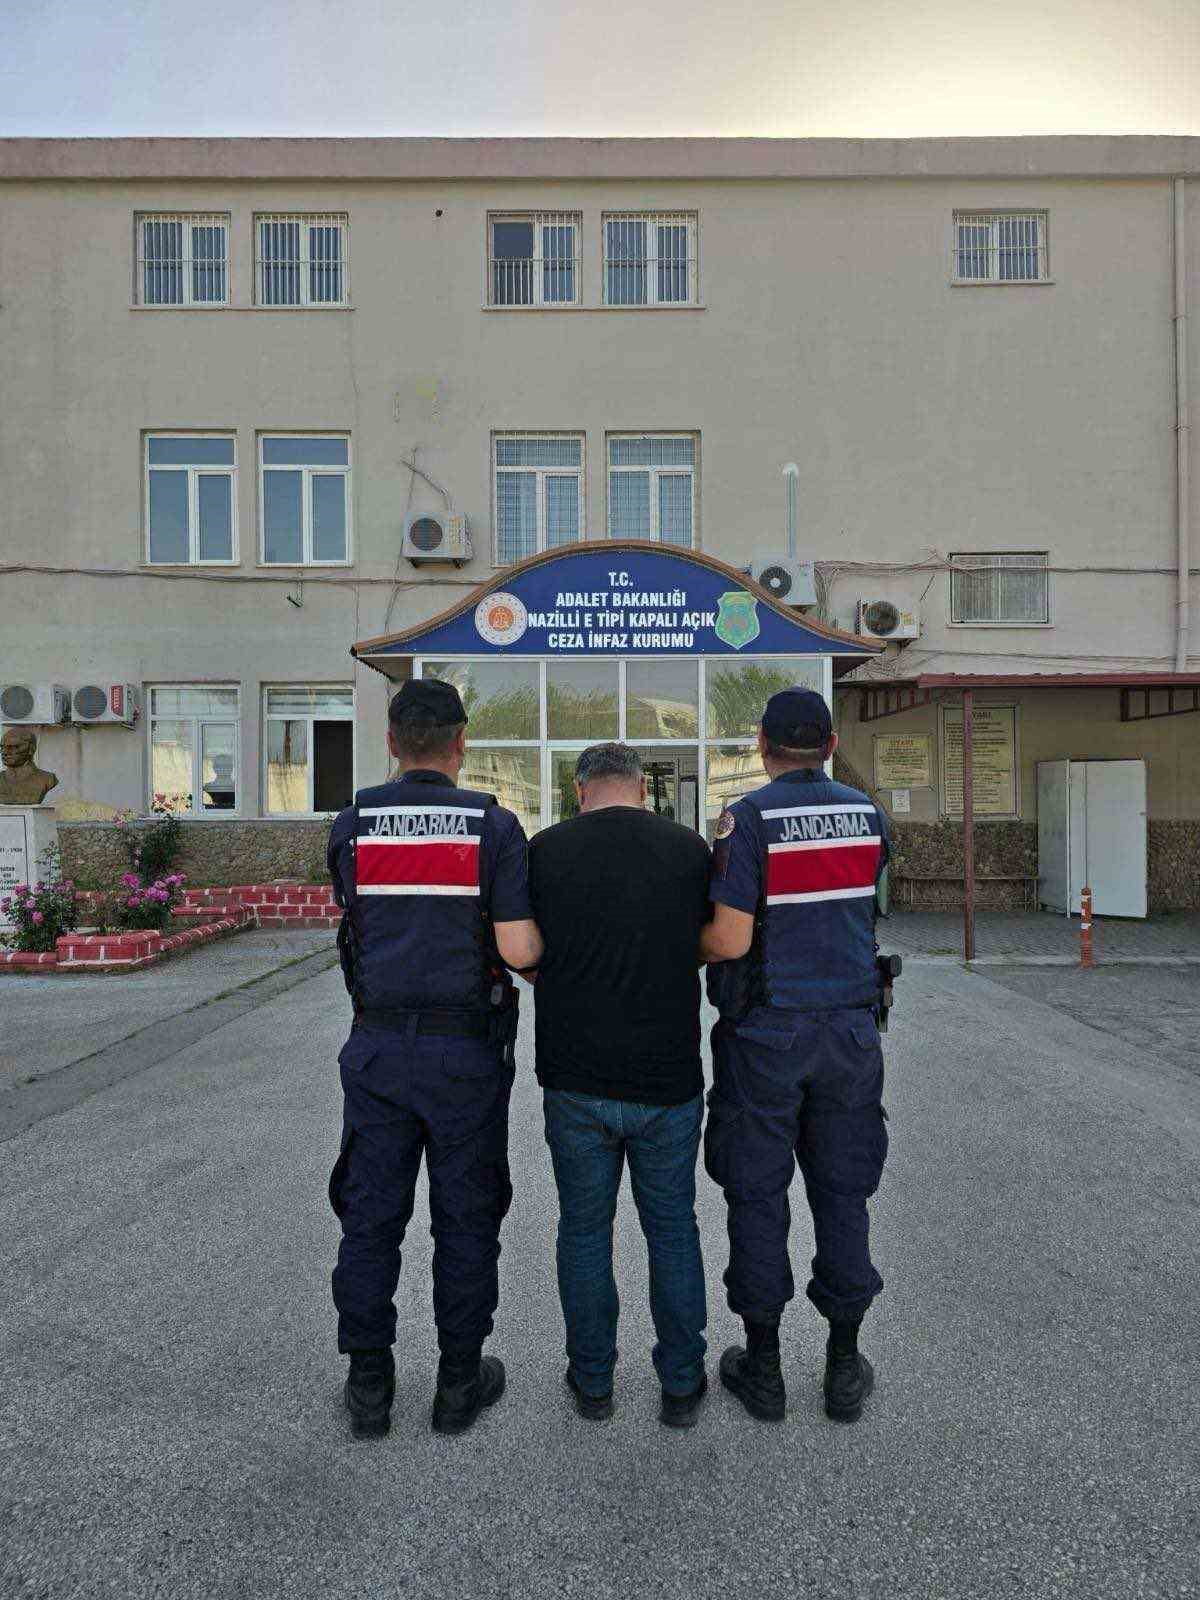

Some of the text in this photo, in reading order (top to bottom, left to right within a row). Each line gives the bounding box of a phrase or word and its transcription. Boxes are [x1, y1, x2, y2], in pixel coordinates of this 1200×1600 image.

[608, 571, 634, 587] T.C.
[556, 588, 687, 607] ADALET BAKANLIĞI
[528, 609, 715, 631] NAZİLLİ E TİPİ KAPALI AÇIK
[548, 630, 694, 648] CEZA İNFAZ KURUMU
[368, 814, 469, 836] JANDARMA
[780, 813, 872, 842] JANDARMA
